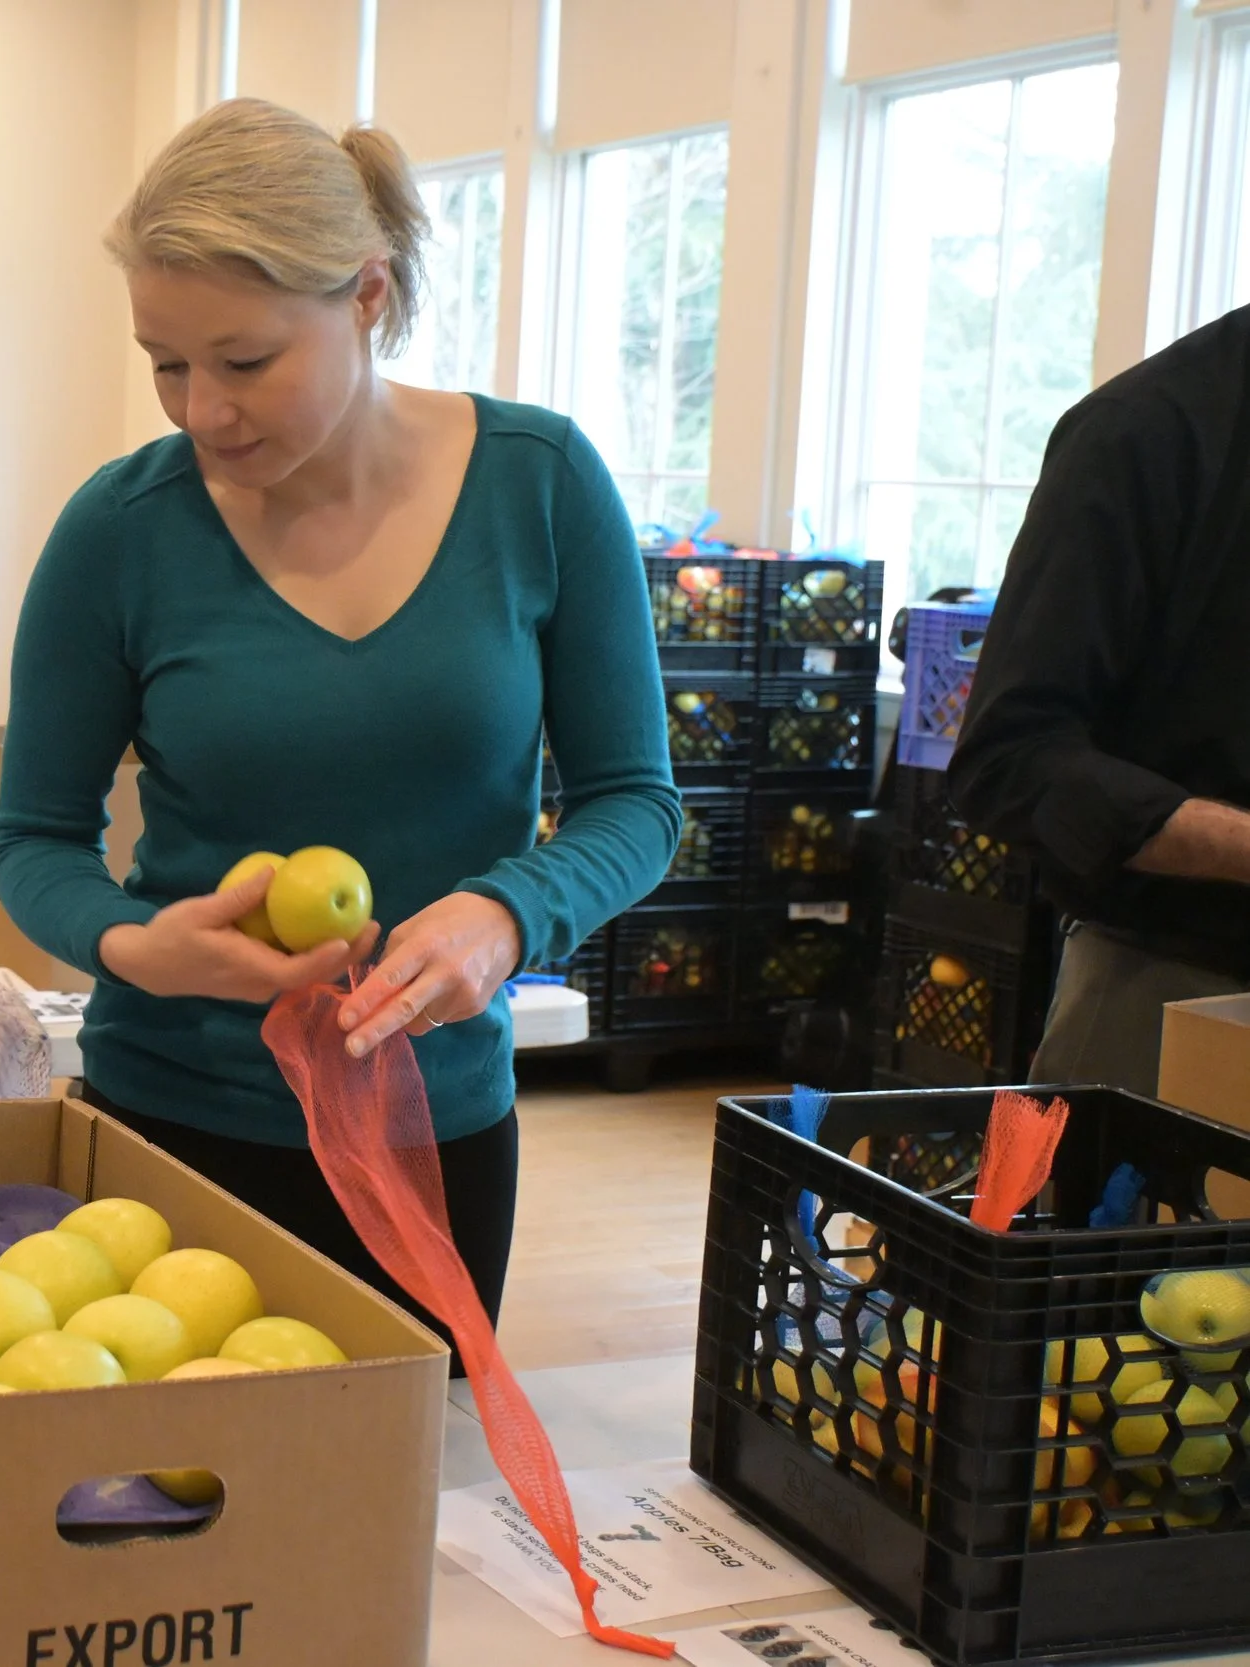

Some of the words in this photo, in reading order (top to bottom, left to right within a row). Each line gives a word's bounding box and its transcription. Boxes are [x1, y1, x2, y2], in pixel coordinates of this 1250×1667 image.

[494, 1496, 510, 1507] Do
[490, 1510, 503, 1518] to
[501, 1517, 528, 1535] stack
[626, 1495, 689, 1534] Apples
[688, 1534, 745, 1568] 7/Bag
[501, 1532, 536, 1556] THANK
[580, 1539, 605, 1557] bags
[603, 1557, 627, 1571] and
[704, 1526, 776, 1570] INSTRUCTIONS
[586, 1562, 617, 1583] crates
[616, 1583, 647, 1601] need
[26, 1602, 254, 1667] EXPORT
